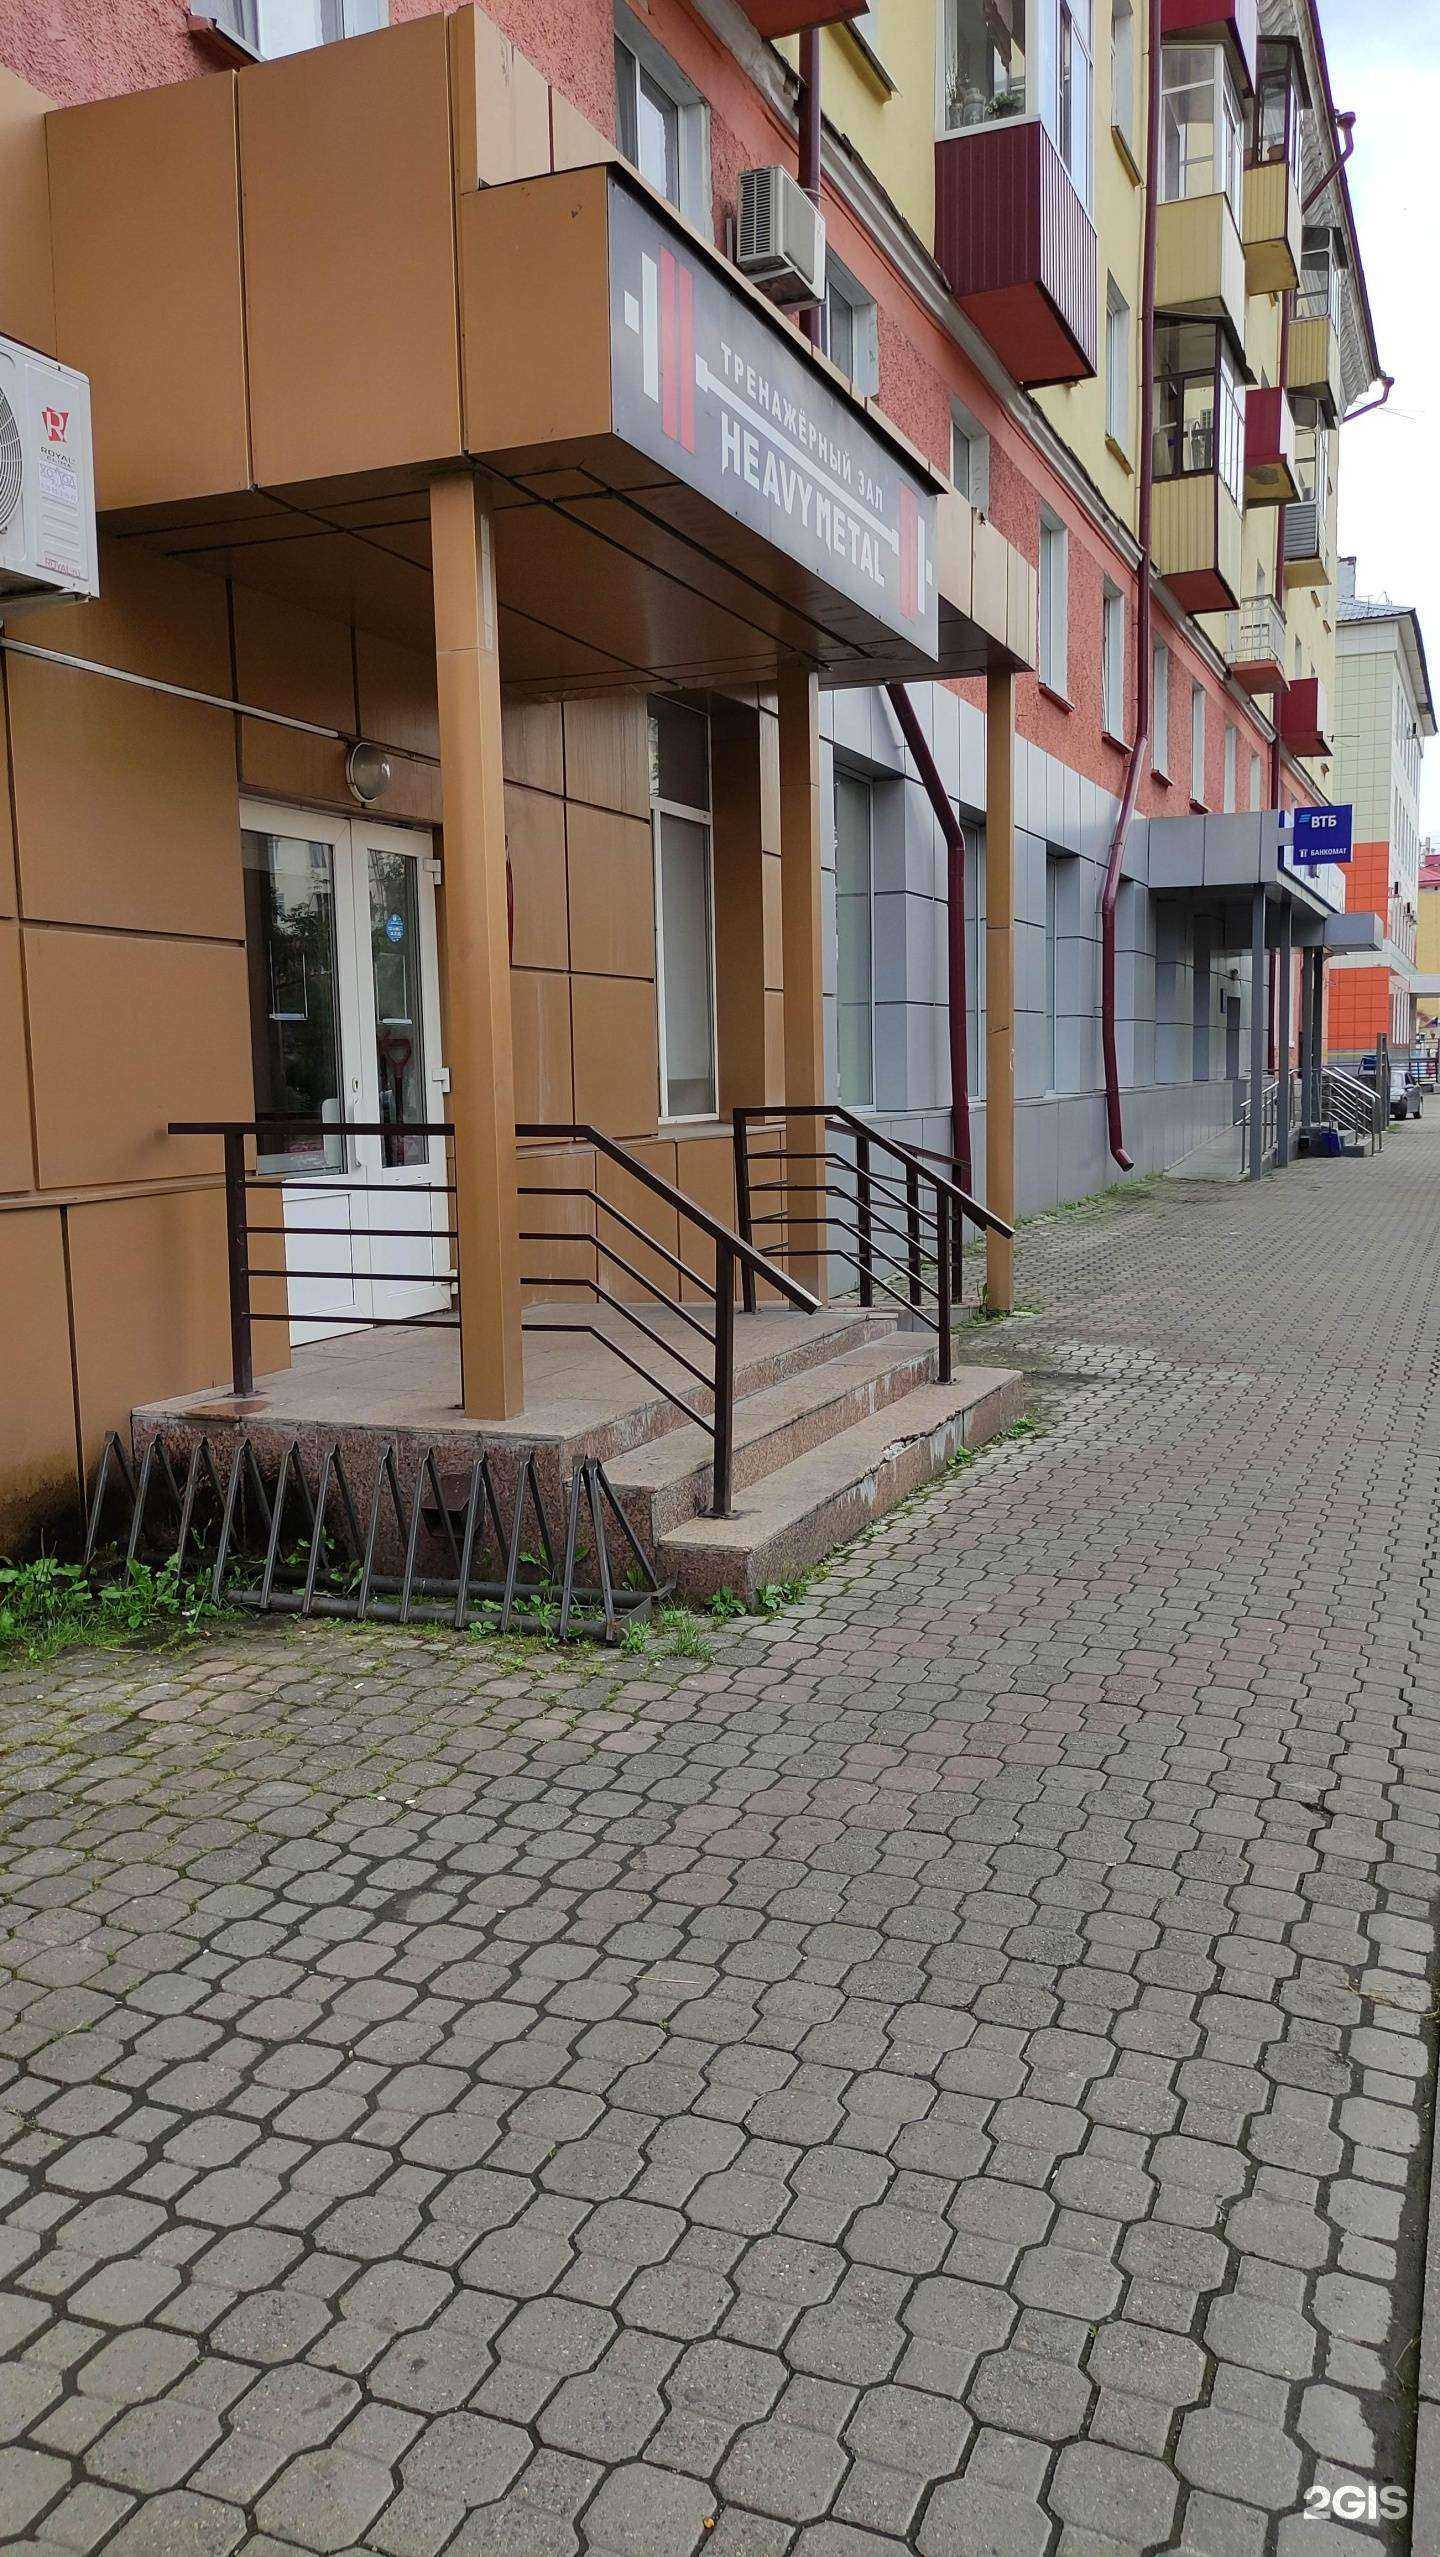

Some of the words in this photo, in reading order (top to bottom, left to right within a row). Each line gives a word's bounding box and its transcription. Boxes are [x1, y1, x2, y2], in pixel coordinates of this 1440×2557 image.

[721, 341, 851, 484] ТРЕНАЖЁРНЫЙ
[857, 471, 884, 512] ЗАЛ
[720, 410, 813, 528] HEAVY
[816, 490, 886, 588] METAL
[1310, 848, 1347, 857] БАНКОМАТ
[1311, 815, 1337, 828] ВТБ
